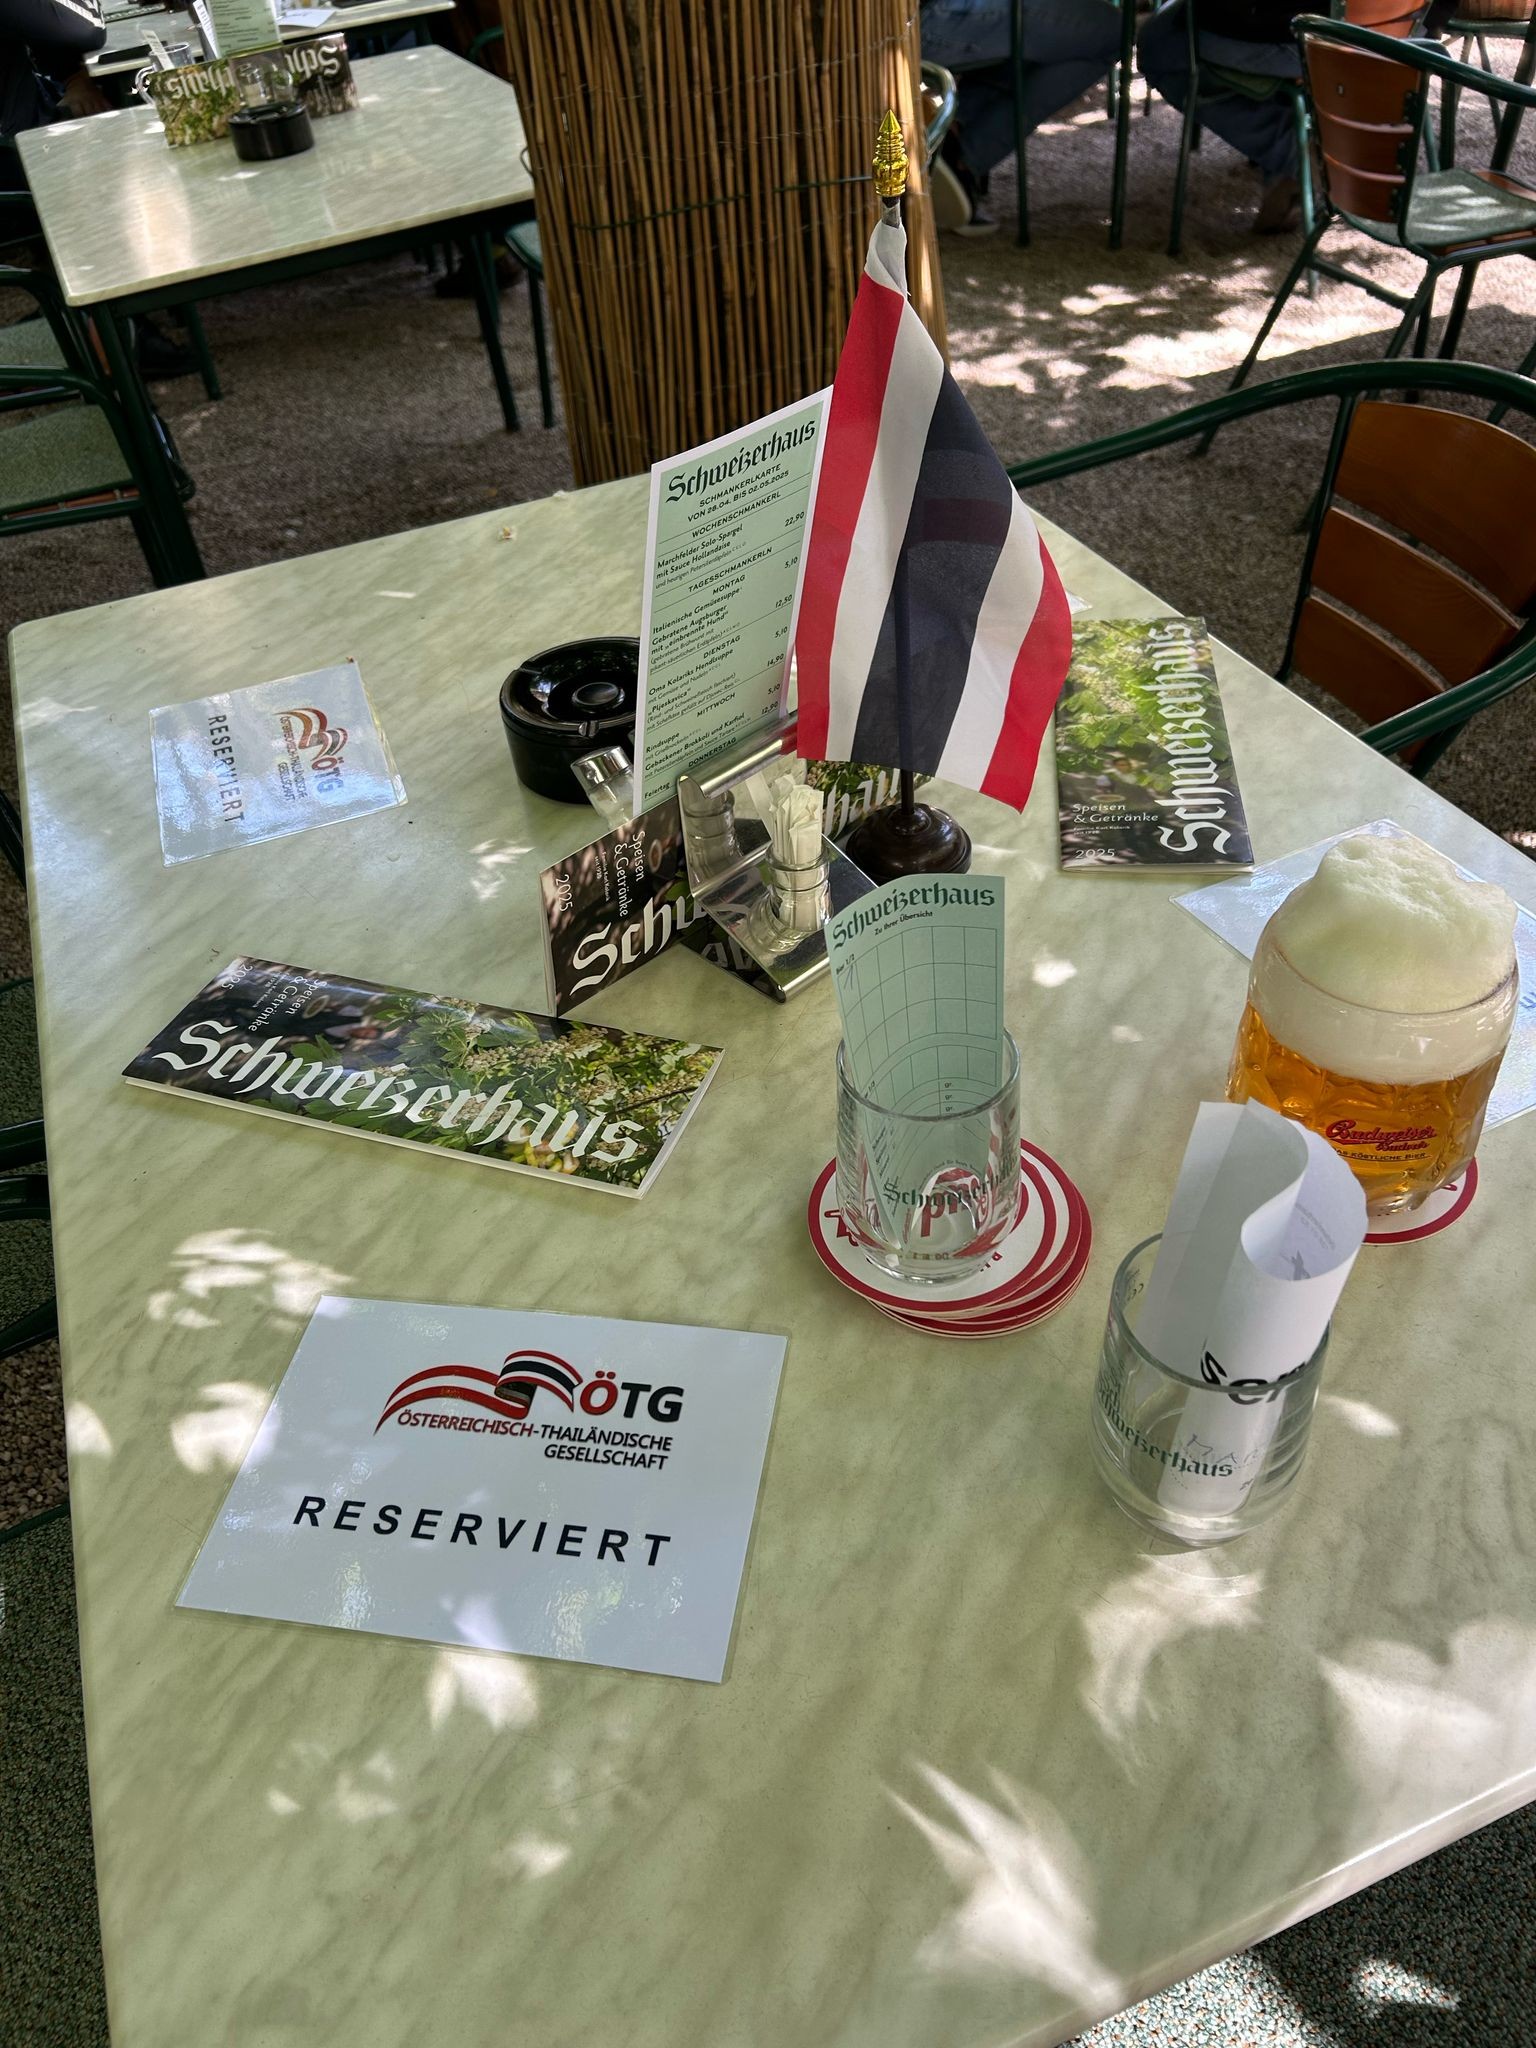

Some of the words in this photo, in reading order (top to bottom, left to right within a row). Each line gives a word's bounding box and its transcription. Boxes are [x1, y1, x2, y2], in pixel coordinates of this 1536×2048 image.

[665, 420, 815, 503] Schweizerhaus
[688, 509, 706, 522] VON
[733, 489, 747, 502] BIS
[748, 470, 789, 494] 02.05.2025
[699, 463, 781, 507] SCHMANKERLKARTE
[692, 491, 781, 538] WOCHENSCHMANKERL
[785, 511, 804, 527] 22,90
[656, 546, 700, 570] Marchfelder
[700, 523, 742, 549] Solo-Spargel
[656, 569, 668, 579] mit
[670, 560, 690, 574] Sauce
[691, 539, 730, 564] Hollandaise
[784, 556, 798, 568] 5,10
[688, 547, 772, 592] TAGESSCHMANKERLN
[713, 574, 745, 595] MONTAG
[651, 625, 688, 645] Gebratene
[689, 605, 727, 628] Augsburger
[652, 612, 692, 635] Italienische
[694, 588, 740, 614] Gemüsesuppe
[651, 645, 663, 655] mit
[703, 635, 740, 659] DIENSTAG
[767, 653, 784, 667] 14,90
[648, 684, 666, 696] Oma
[667, 670, 694, 686] Kolariks
[695, 649, 733, 672] Hendlsuppe
[697, 692, 735, 717] MITTWOCH
[645, 748, 683, 771] Gebackener
[684, 732, 710, 750] Brokkoli
[711, 724, 723, 735] und
[724, 712, 744, 728] Karfiol
[646, 732, 679, 753] Rindsuppe
[688, 737, 736, 767] DONNERSTAG
[1139, 623, 1235, 855] Schweizerhaus
[208, 714, 245, 821] RESERVIERT
[312, 756, 344, 792] ÖTG
[644, 782, 670, 801] Feiertag
[1072, 803, 1126, 814] Speisen
[1073, 814, 1087, 823] &
[1089, 812, 1159, 823] Getränke
[614, 843, 627, 859] &
[628, 830, 646, 882] Speisen
[1075, 848, 1115, 859] 2025
[555, 874, 573, 912] 2025
[616, 857, 633, 917] Getränke
[832, 882, 995, 950] Schweizerhaus
[874, 928, 882, 936] Zu
[899, 911, 934, 923] Übersicht
[221, 964, 253, 990] 2025
[289, 976, 308, 984] &
[248, 985, 298, 1031] Getränke
[285, 978, 328, 1015] Speisen
[152, 1020, 649, 1164] Schweizerhaus
[1326, 1120, 1438, 1143] Budweiser
[1334, 1148, 1348, 1156] AS
[579, 1370, 685, 1422] ÖTG
[397, 1409, 673, 1451] ÖSTERREICHISCH-THAILÄNDISCHE
[543, 1443, 668, 1471] GESELLSCHAFT
[293, 1495, 671, 1566] RESERVIERT
